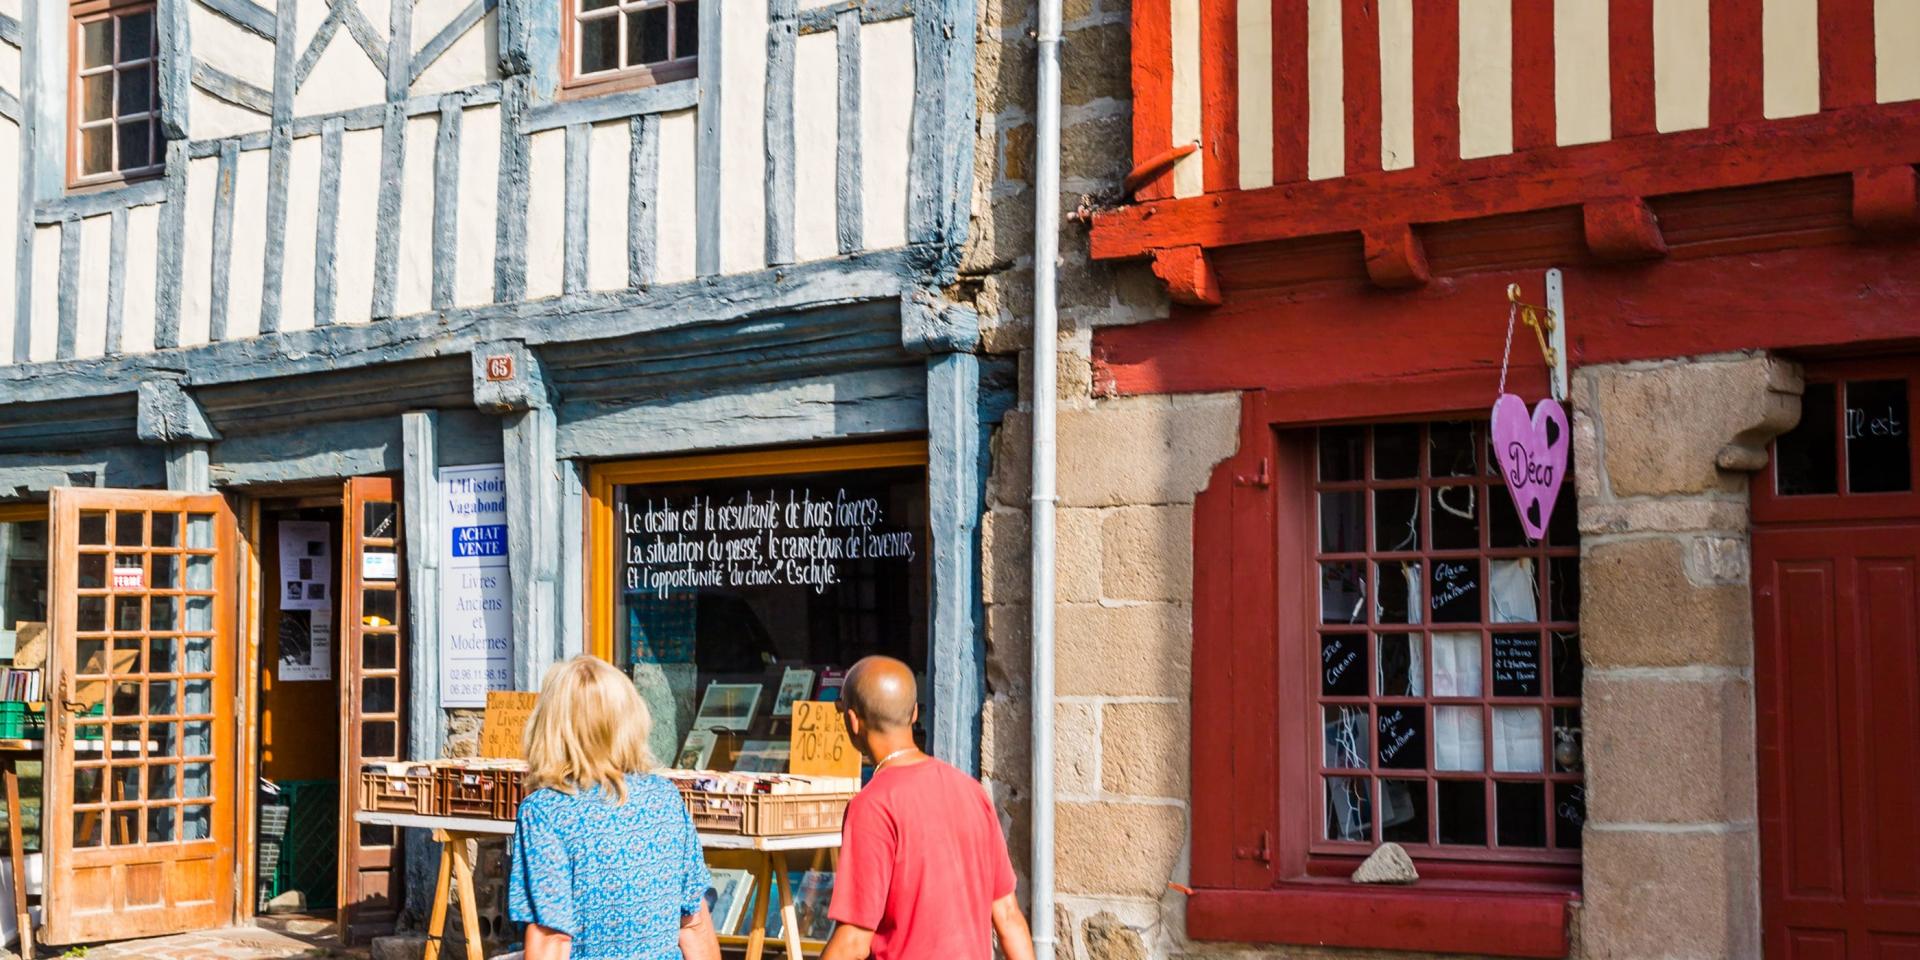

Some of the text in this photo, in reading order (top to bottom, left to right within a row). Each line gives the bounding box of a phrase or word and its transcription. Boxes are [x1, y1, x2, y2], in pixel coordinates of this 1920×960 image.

[492, 359, 508, 377] 65
[1845, 406, 1901, 439] Il est
[1508, 441, 1553, 489] Déco
[449, 476, 505, 494] L'Histoir
[449, 495, 505, 514] Vagabond
[644, 497, 679, 533] destin
[682, 495, 702, 532] est
[704, 495, 714, 531] la
[718, 488, 780, 531] résultante
[785, 488, 800, 529] de
[802, 488, 834, 528] trois
[459, 526, 500, 541] ACHAT
[459, 541, 500, 556] VENTE
[626, 536, 644, 564] La
[646, 532, 704, 563] situation
[707, 532, 723, 561] du
[725, 529, 763, 572] passé,
[769, 529, 780, 560] le
[781, 527, 844, 560] carrefour
[846, 528, 860, 559] de
[462, 573, 497, 589] Livres
[627, 565, 640, 589] Et
[643, 561, 724, 600] l'opportunité
[730, 562, 745, 586] du
[456, 596, 502, 611] Anciens
[472, 616, 483, 629] et
[450, 634, 507, 650] Modernes
[1322, 640, 1343, 664] Ice
[833, 734, 845, 762] 6
